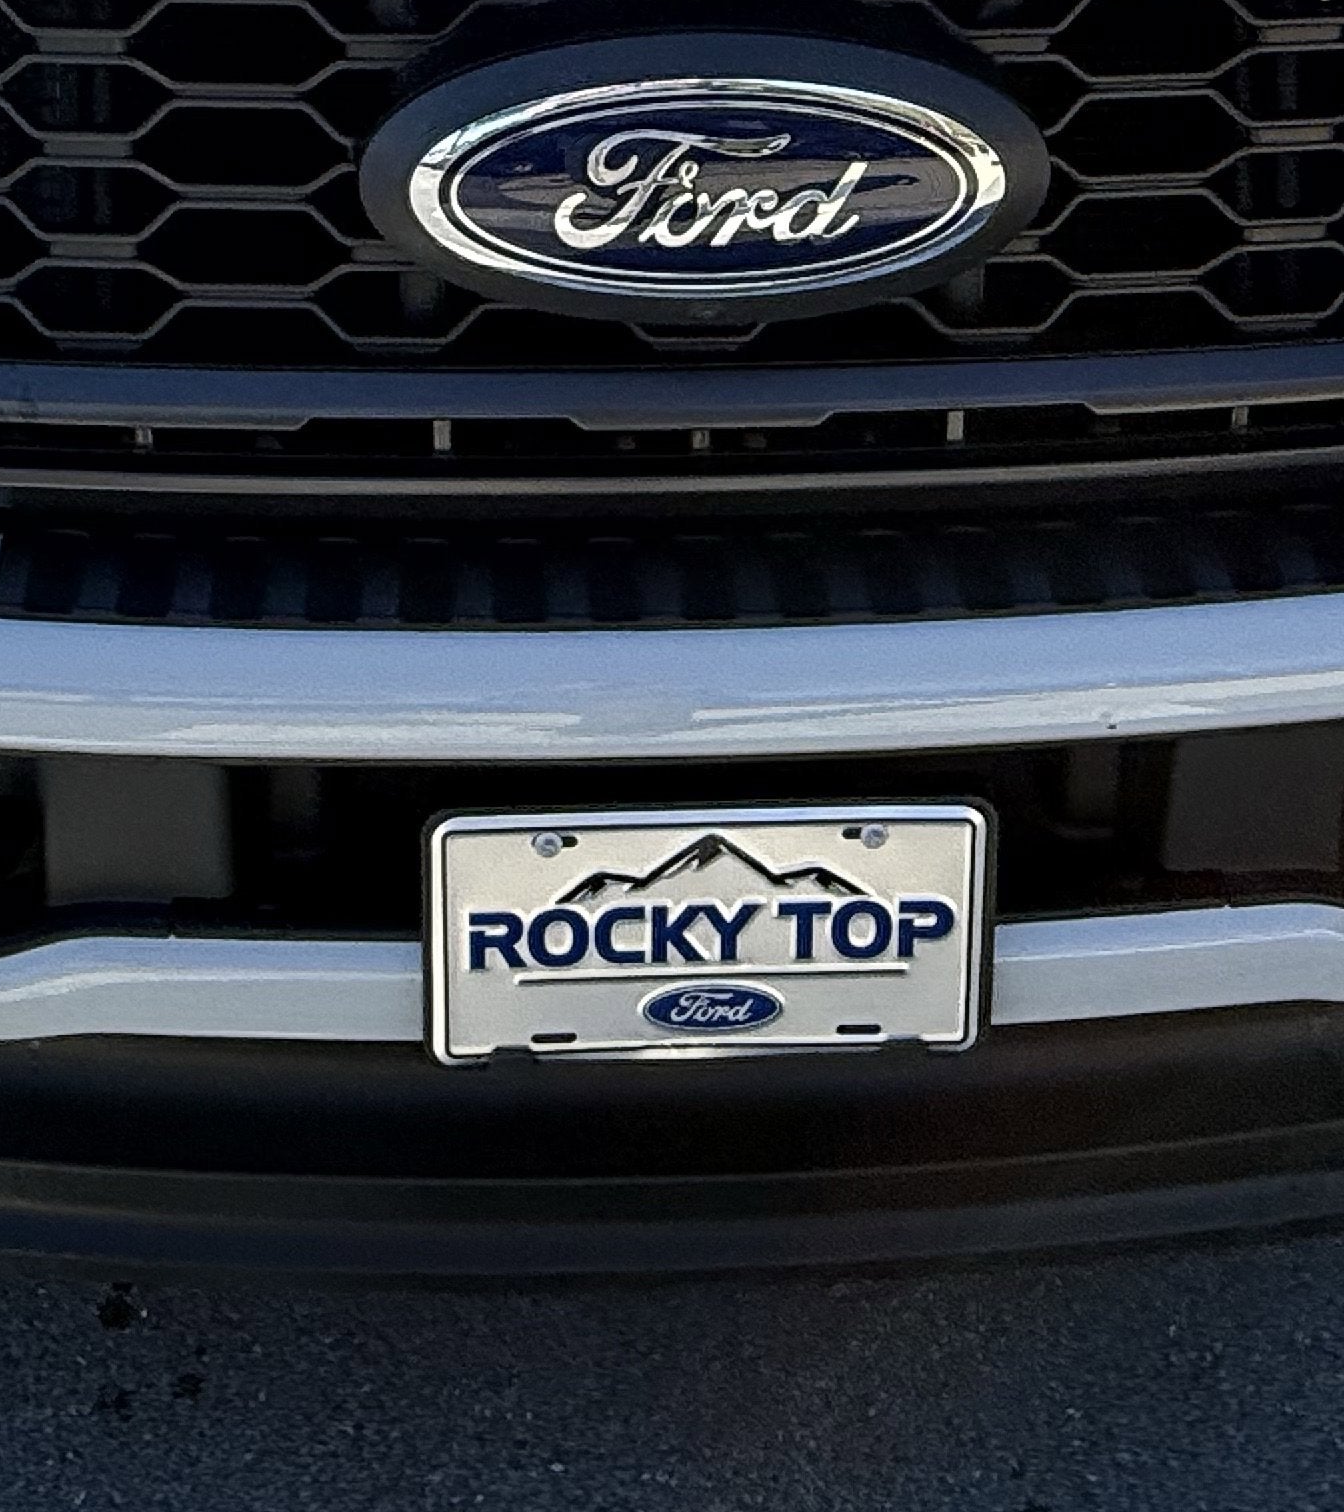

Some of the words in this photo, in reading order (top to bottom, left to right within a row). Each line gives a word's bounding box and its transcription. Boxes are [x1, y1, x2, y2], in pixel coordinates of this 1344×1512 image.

[554, 129, 868, 249] Ford
[468, 901, 762, 972] ROCKY
[777, 899, 955, 961] TOP
[669, 992, 753, 1025] Ford
